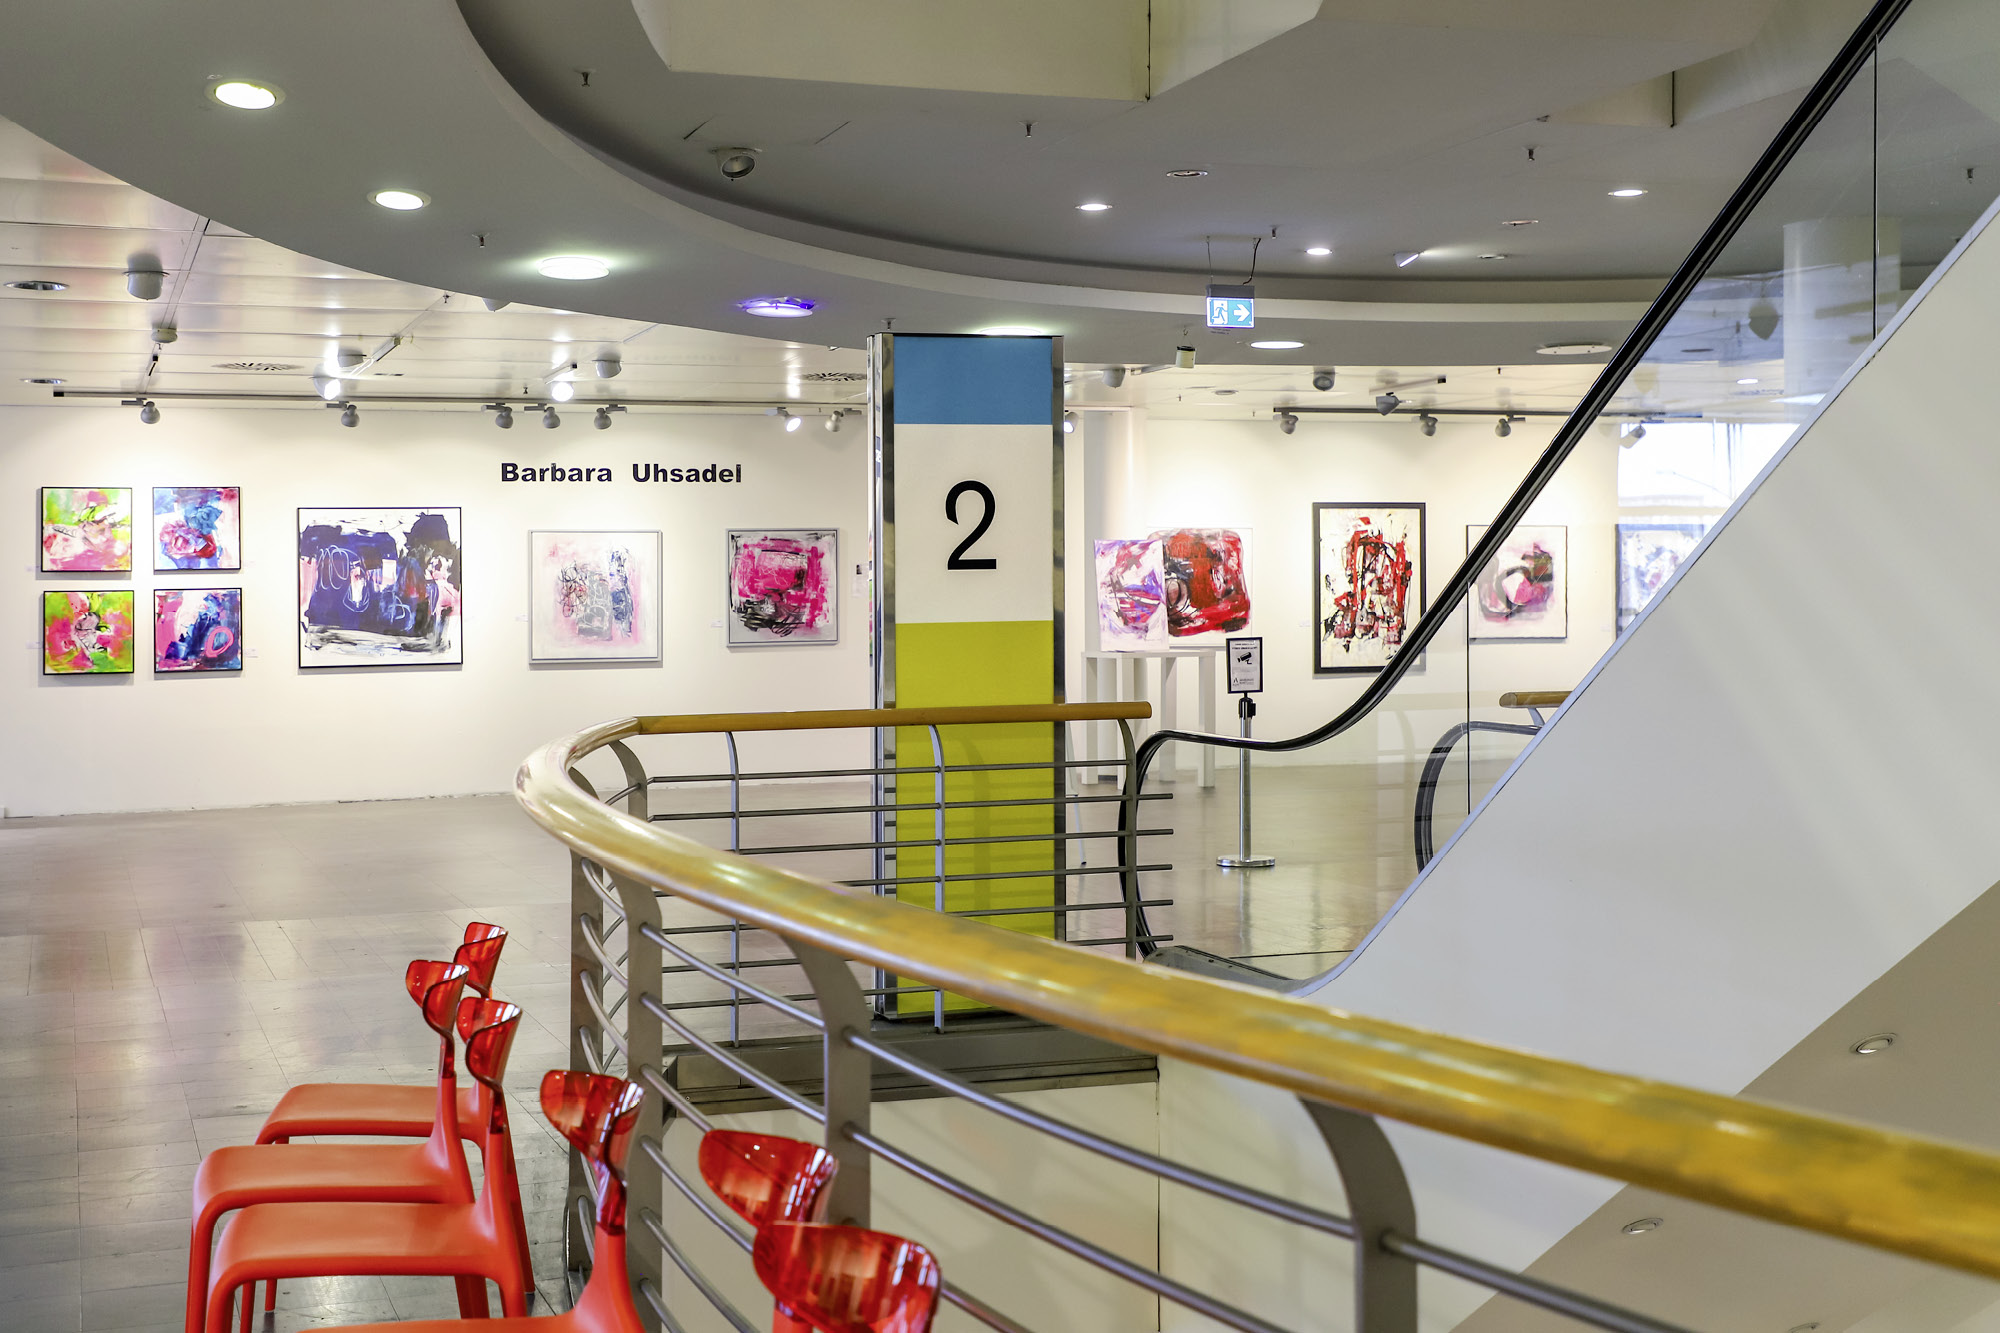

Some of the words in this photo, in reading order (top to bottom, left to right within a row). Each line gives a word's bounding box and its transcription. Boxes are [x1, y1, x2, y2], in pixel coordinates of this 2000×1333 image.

[501, 462, 612, 482] Barbara
[632, 463, 741, 482] Uhsadel
[946, 480, 996, 570] 2
